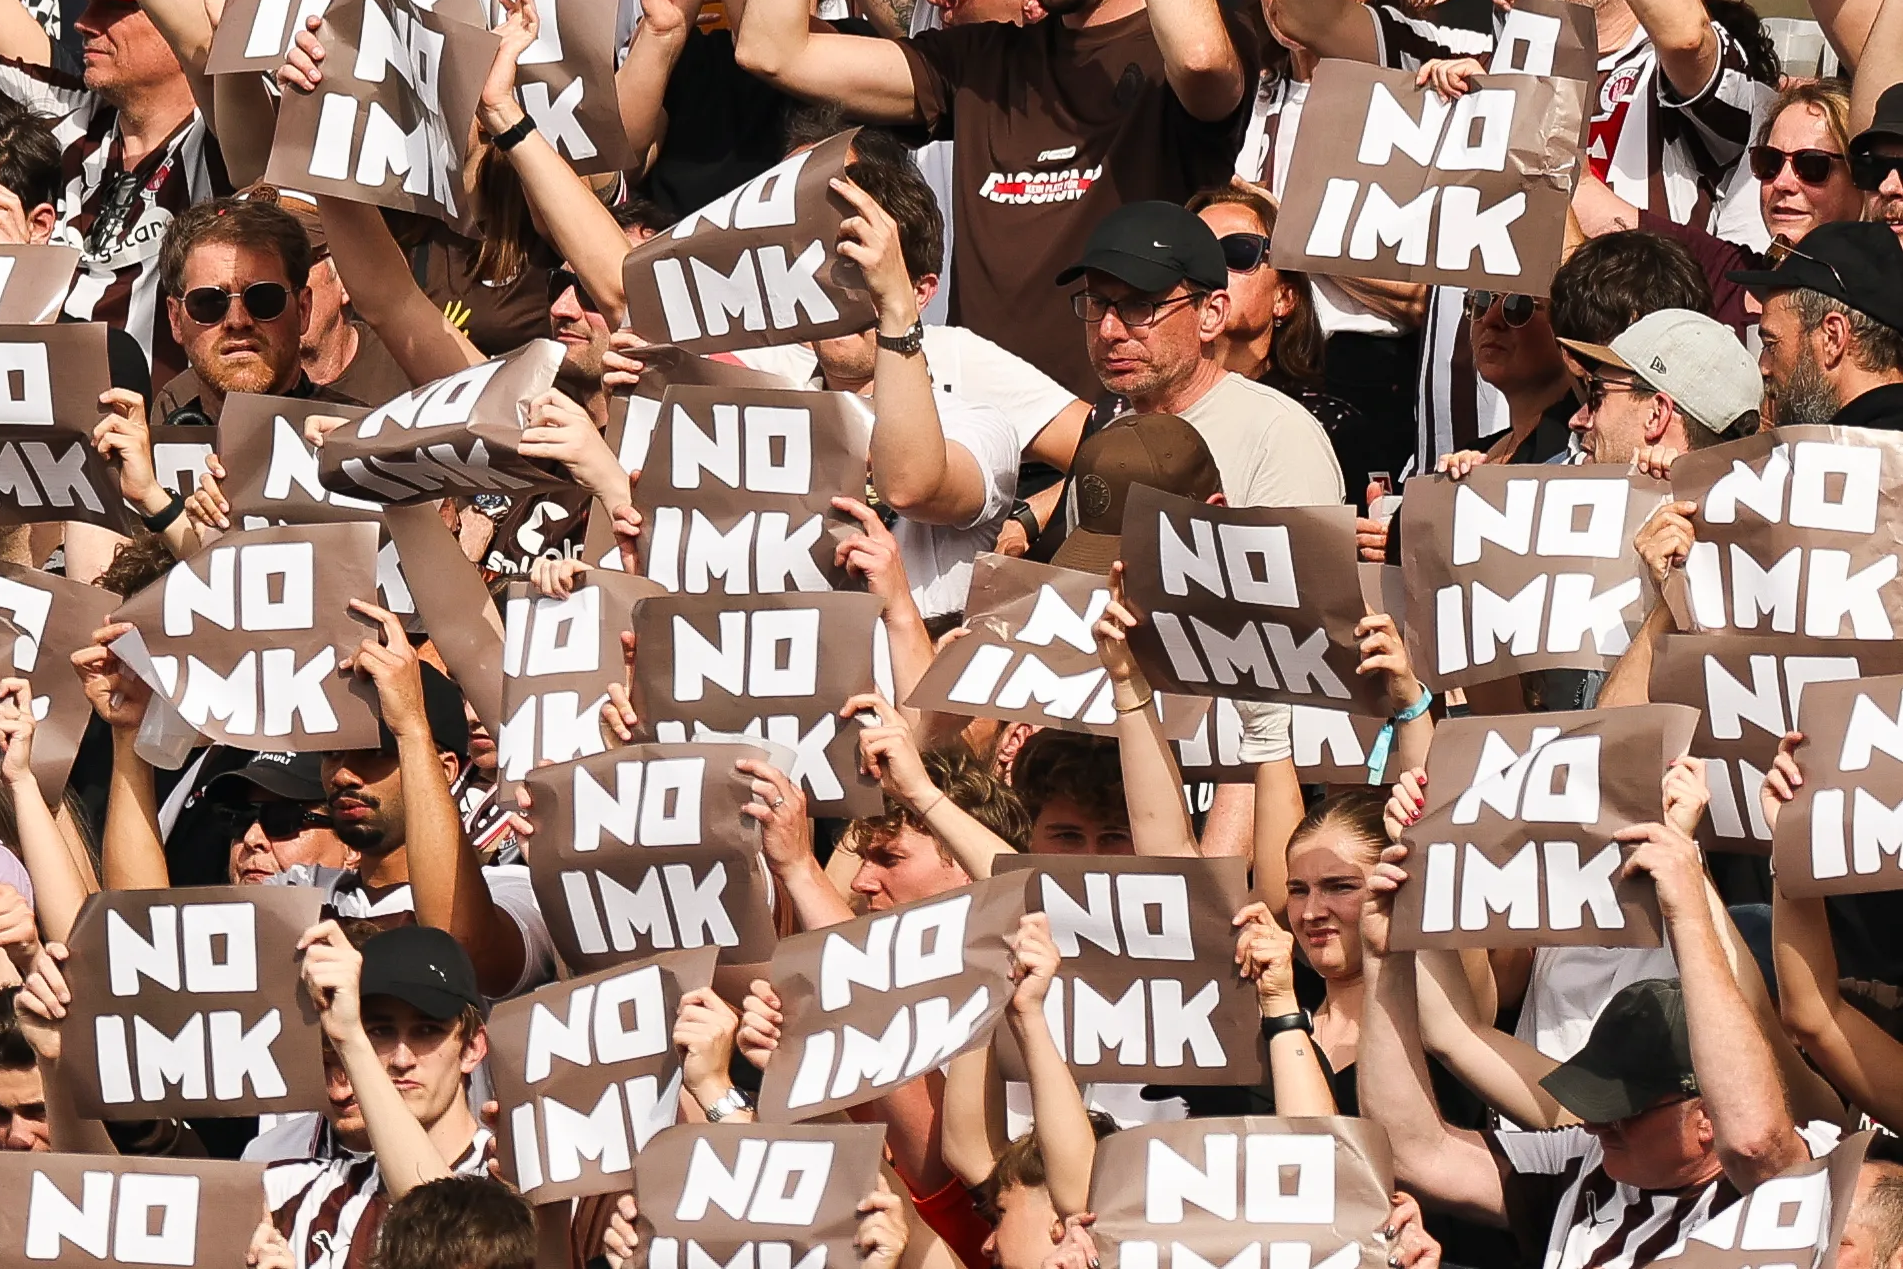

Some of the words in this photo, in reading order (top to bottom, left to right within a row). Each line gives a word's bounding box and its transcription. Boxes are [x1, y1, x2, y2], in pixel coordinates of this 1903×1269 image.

[1357, 82, 1517, 173] NO
[1306, 178, 1527, 276] IMK
[652, 238, 840, 343] IMK
[359, 359, 504, 440] NO
[343, 438, 532, 498] IMK
[671, 403, 812, 494] NO
[1705, 442, 1881, 534] NO
[648, 506, 834, 596] IMK
[1159, 511, 1298, 608] NO
[1454, 479, 1630, 566] NO
[164, 542, 313, 637] NO
[1434, 572, 1637, 676] IMK
[1687, 542, 1899, 640] IMK
[671, 609, 819, 701] NO
[1151, 611, 1352, 700] IMK
[573, 756, 706, 853] NO
[1451, 726, 1601, 825] NO
[560, 860, 740, 955] IMK
[1041, 873, 1194, 960] NO
[1422, 840, 1625, 934] IMK
[106, 902, 257, 996] NO
[820, 893, 973, 1012] NO
[95, 1007, 287, 1104] IMK
[524, 965, 667, 1083] NO
[787, 985, 989, 1109] IMK
[25, 1170, 199, 1265] NO
[676, 1138, 834, 1225] NO
[1146, 1132, 1334, 1225] NO
